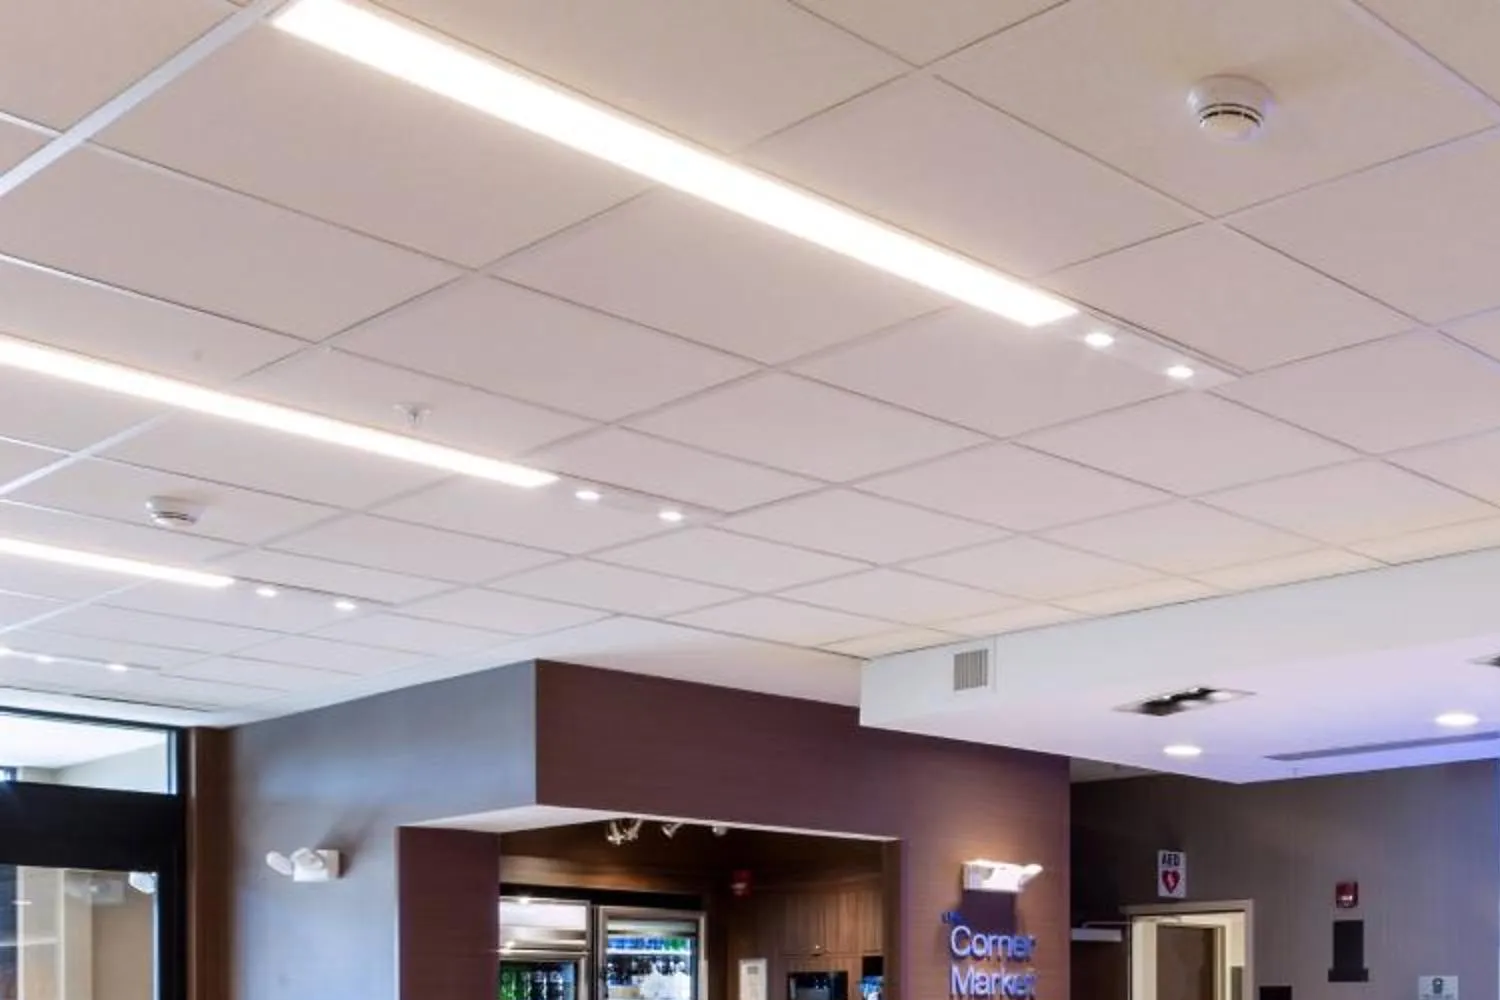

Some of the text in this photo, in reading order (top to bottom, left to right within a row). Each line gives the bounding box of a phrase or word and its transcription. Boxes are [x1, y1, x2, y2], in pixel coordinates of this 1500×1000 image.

[1162, 853, 1181, 866] AED
[950, 925, 1035, 957] Corner
[950, 963, 1035, 996] Market
